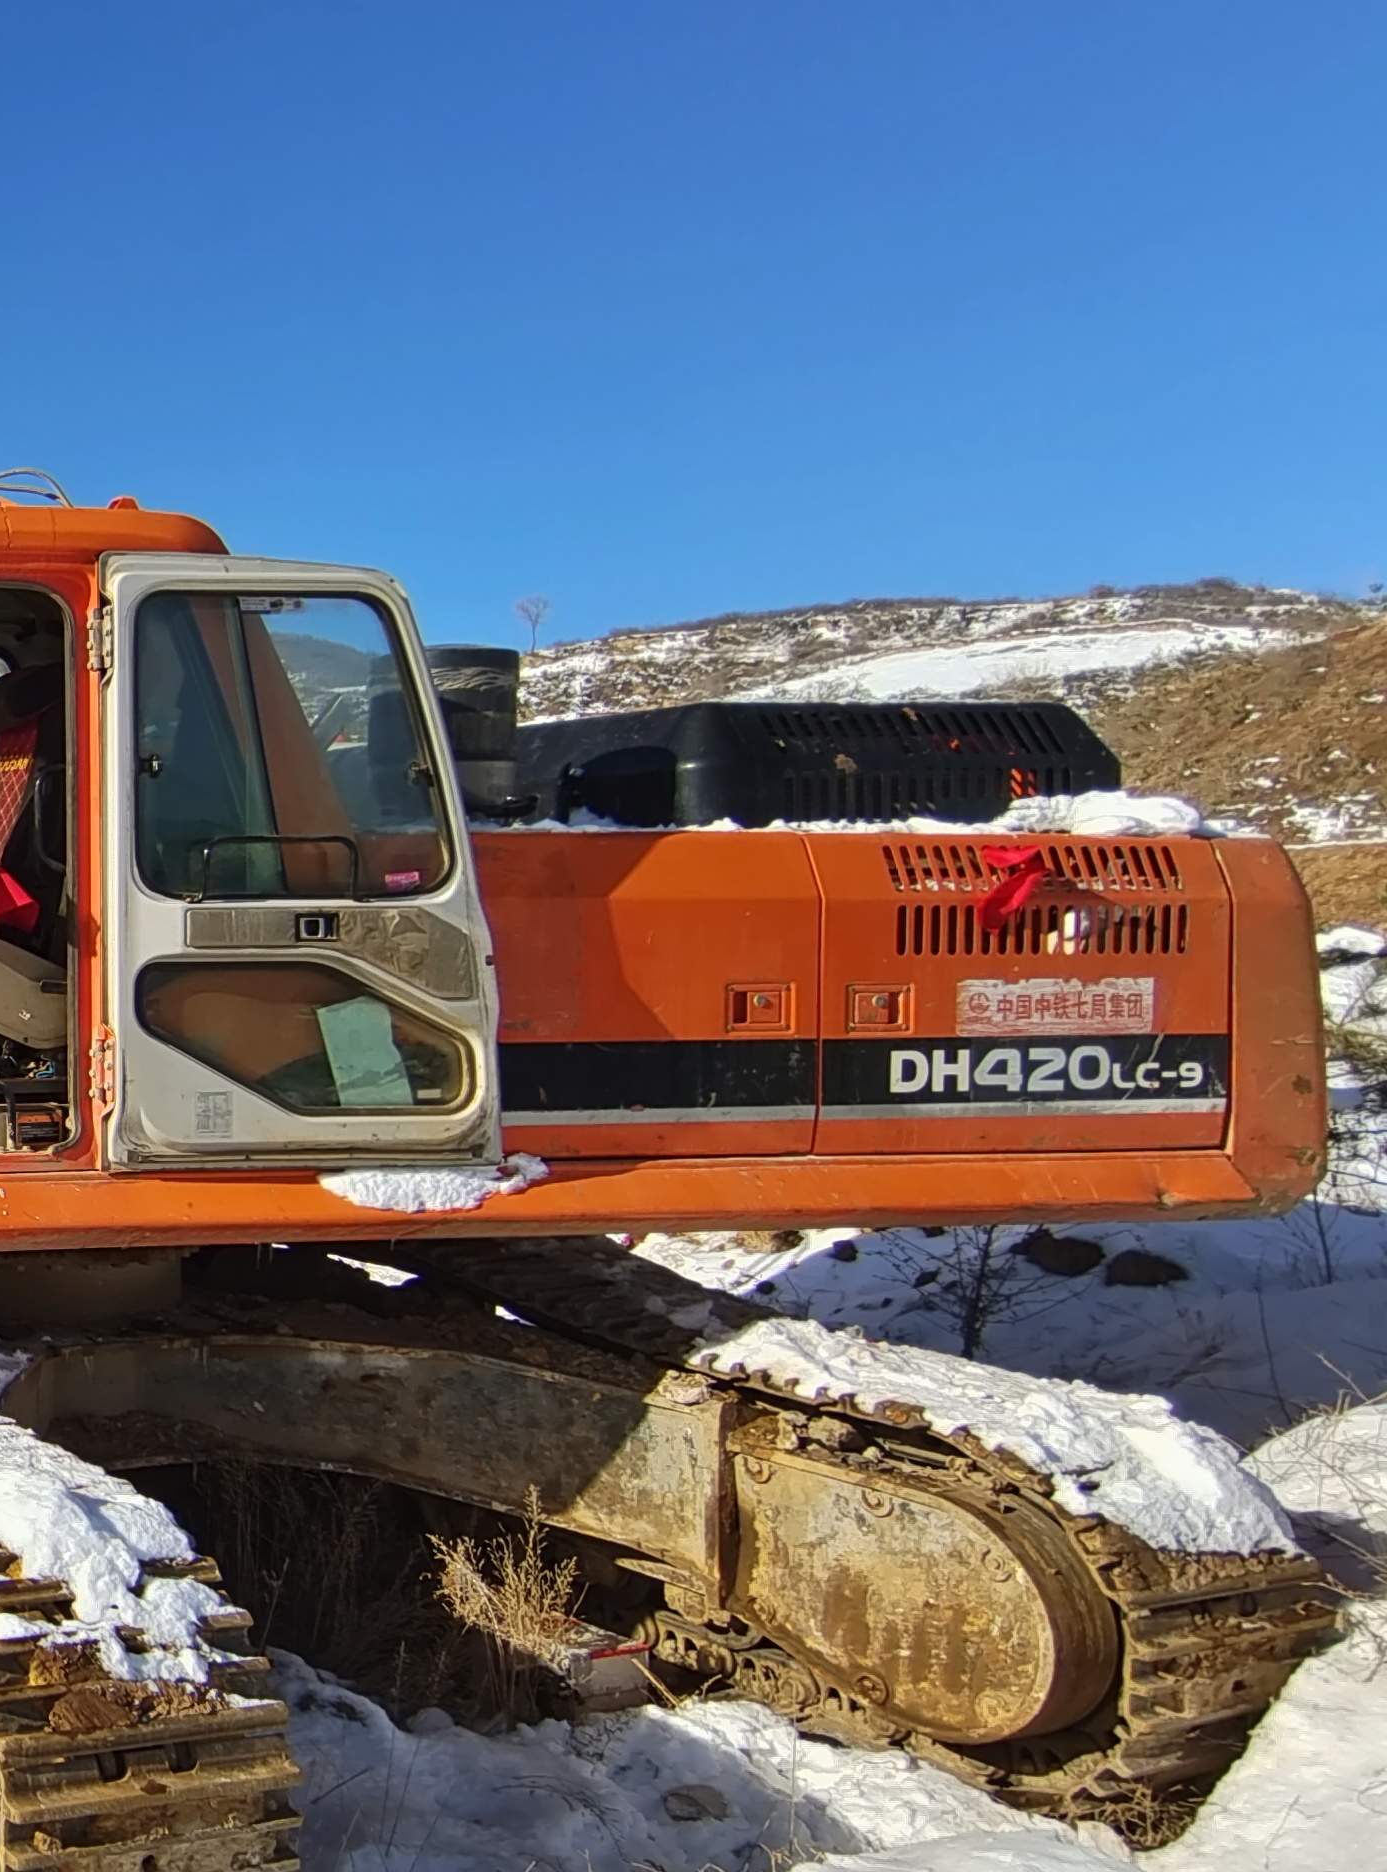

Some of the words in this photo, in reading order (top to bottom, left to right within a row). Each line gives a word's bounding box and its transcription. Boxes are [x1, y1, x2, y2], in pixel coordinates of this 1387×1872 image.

[997, 991, 1144, 1021] 中国中铁七局集团
